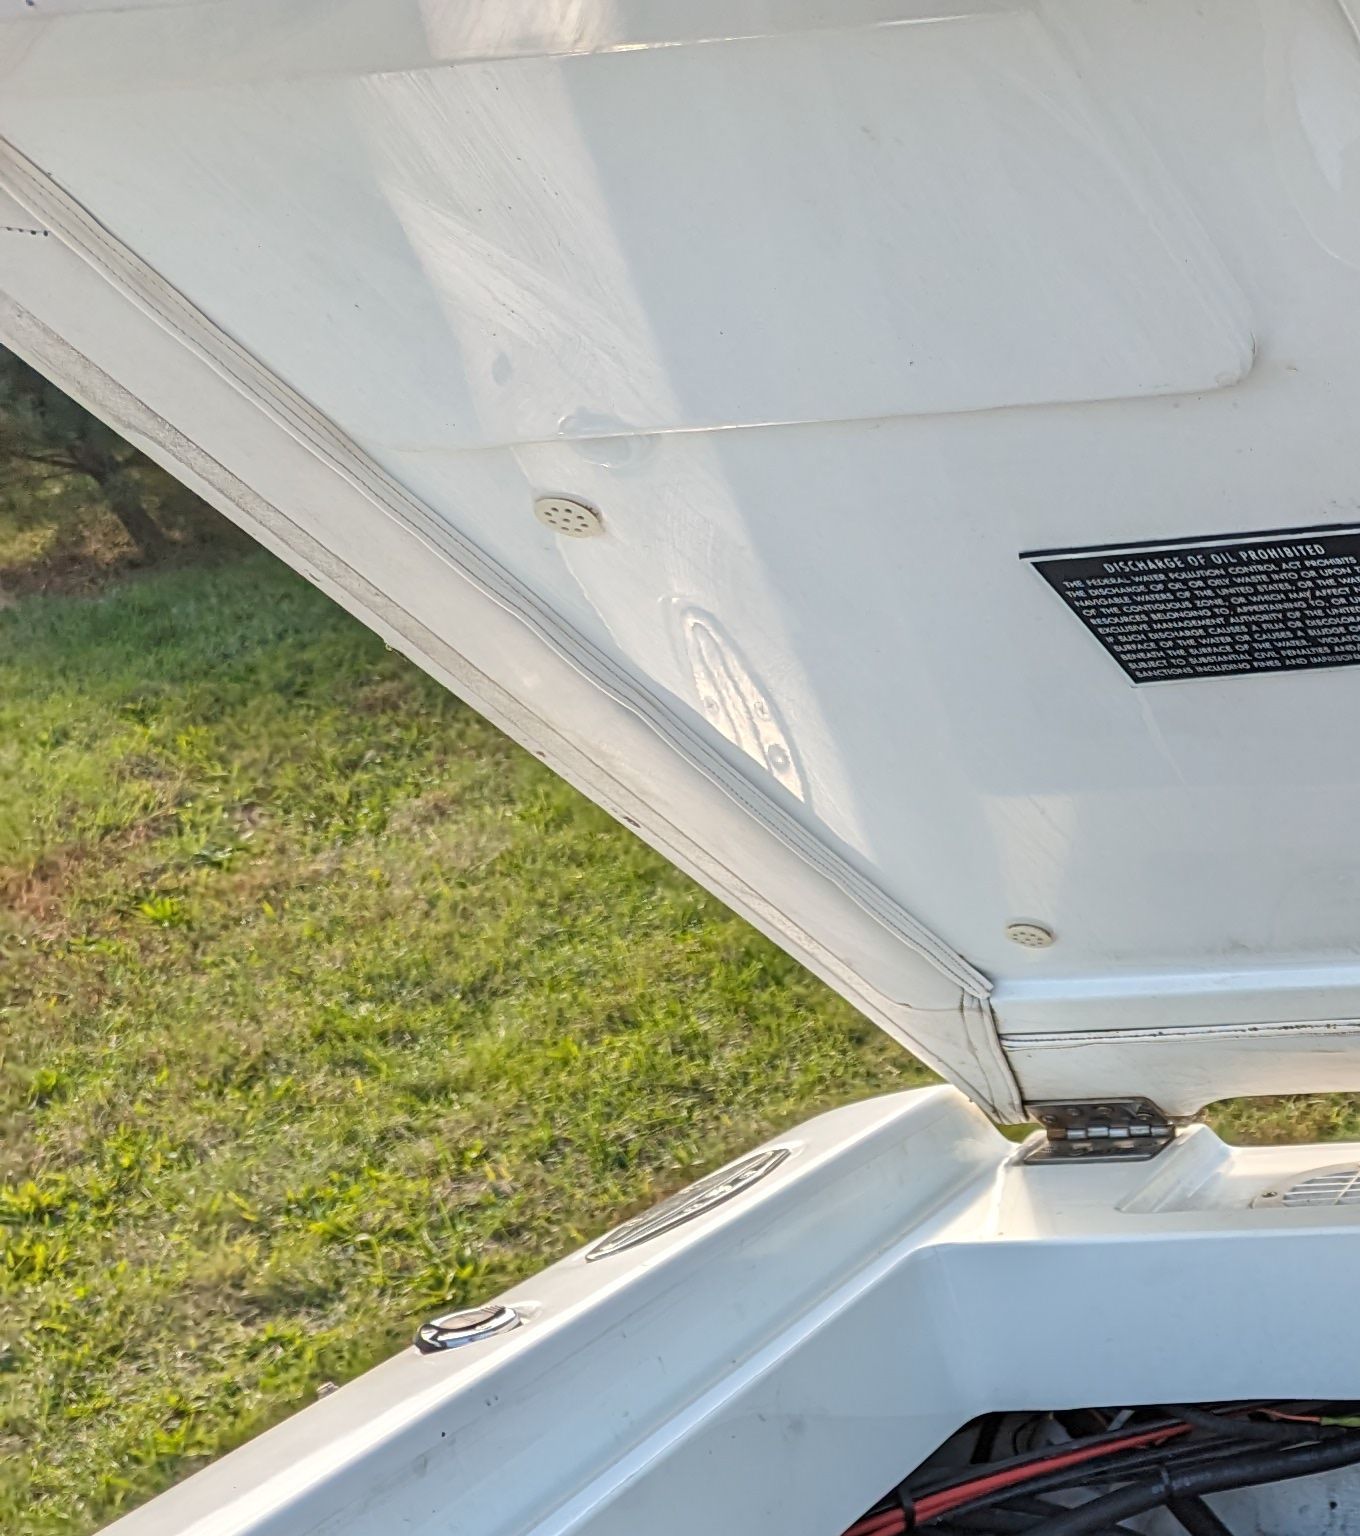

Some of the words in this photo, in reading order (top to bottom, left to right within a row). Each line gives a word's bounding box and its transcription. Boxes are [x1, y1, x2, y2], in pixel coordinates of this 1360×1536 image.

[1102, 558, 1185, 573] DISCHARGE
[1186, 556, 1208, 566] OF
[1209, 553, 1238, 564] OIL
[1238, 545, 1327, 561] PROHIBITED
[1085, 577, 1130, 586] FEDERAL
[1131, 574, 1167, 582] WATER
[1168, 568, 1226, 579] POLLUTION
[1227, 564, 1279, 574] CONTROL
[1304, 557, 1357, 567] PROHIBITS
[1088, 585, 1148, 596] DISCHARGE
[1206, 578, 1232, 586] OILY
[1232, 575, 1269, 584] WASTE
[1319, 568, 1352, 576] UPON
[1074, 597, 1132, 607] NAVIGABLE
[1133, 593, 1174, 602] WATERS
[1216, 586, 1254, 595] UNITED
[1257, 583, 1295, 592] STATES,
[1122, 602, 1193, 613] CONTIGUOUS
[1194, 599, 1228, 607] ZONE,
[1248, 594, 1286, 602] WHICH
[1287, 591, 1313, 599] MAY
[1314, 588, 1352, 597] AFFECT
[1089, 615, 1150, 625] RESOURCES
[1150, 610, 1213, 620] BELONGING
[1234, 601, 1308, 613] APPERTAINING
[1098, 625, 1150, 634] EXCLUSIVE
[1152, 618, 1226, 630] MANAGEMENT
[1228, 613, 1284, 623] AUTHORITY
[1113, 643, 1157, 652] SURFACE
[1253, 632, 1293, 640] CAUSES
[1148, 630, 1206, 639] DISCHARGE
[1207, 626, 1248, 634] CAUSES
[1120, 652, 1166, 660] BENEATH
[1189, 646, 1233, 655] SURFACE
[1274, 639, 1311, 647] WATER.
[1128, 661, 1170, 670] SUBJECT
[1188, 654, 1252, 664] SUBSTANTIAL
[1253, 651, 1279, 659] CIVIL
[1280, 647, 1331, 656] PENALTIES
[1135, 668, 1195, 678] SANCTIONS
[1195, 663, 1252, 673] INCLUDING
[1252, 660, 1282, 668] FINES
